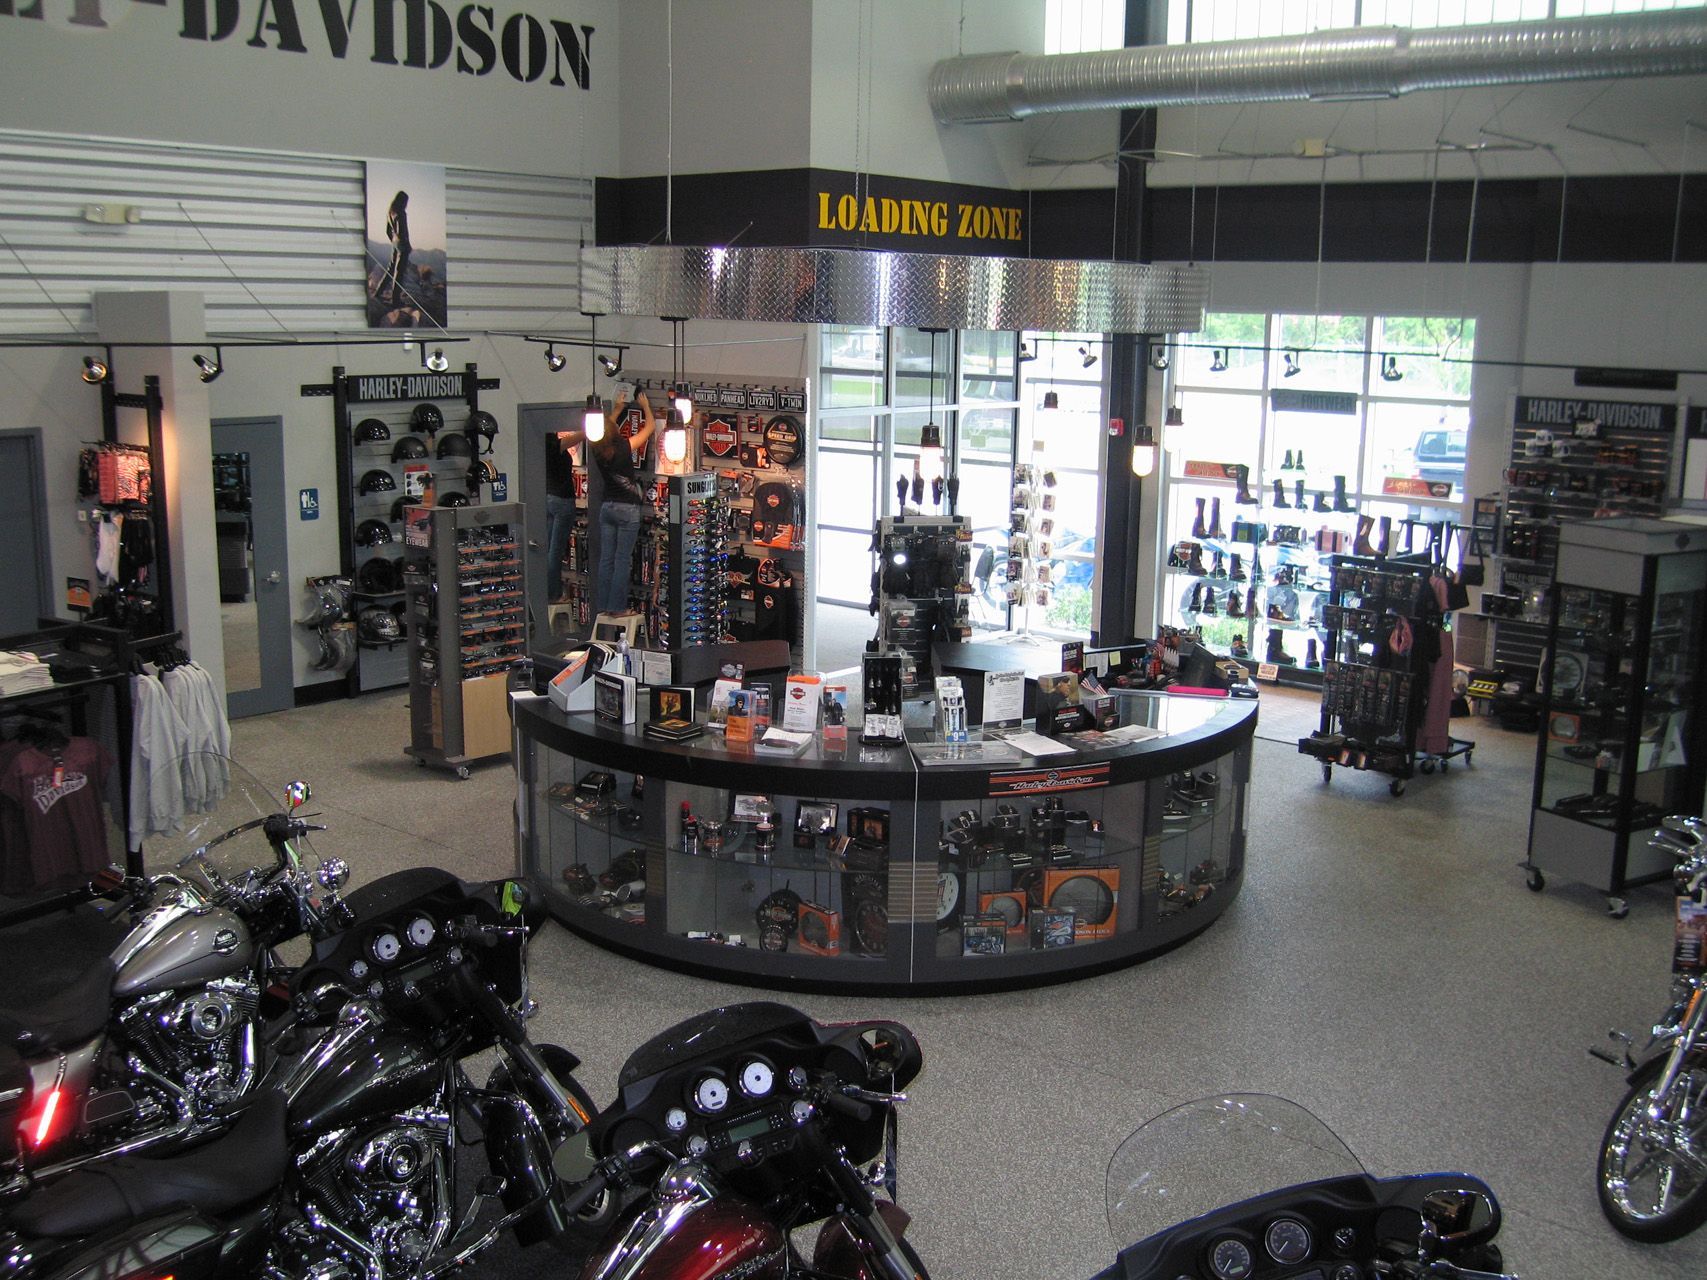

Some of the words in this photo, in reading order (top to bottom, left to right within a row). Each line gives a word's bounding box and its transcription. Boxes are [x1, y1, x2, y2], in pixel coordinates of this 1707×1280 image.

[0, 0, 597, 90] DAVIDSON
[818, 192, 949, 237] LOADING
[957, 204, 1023, 241] ZONE
[359, 376, 463, 400] HARLEY-DAVIDSON
[720, 394, 745, 404] PANHEAD
[780, 397, 803, 409] V-TWIN
[1526, 399, 1663, 429] HARLEY-DAVIDSON
